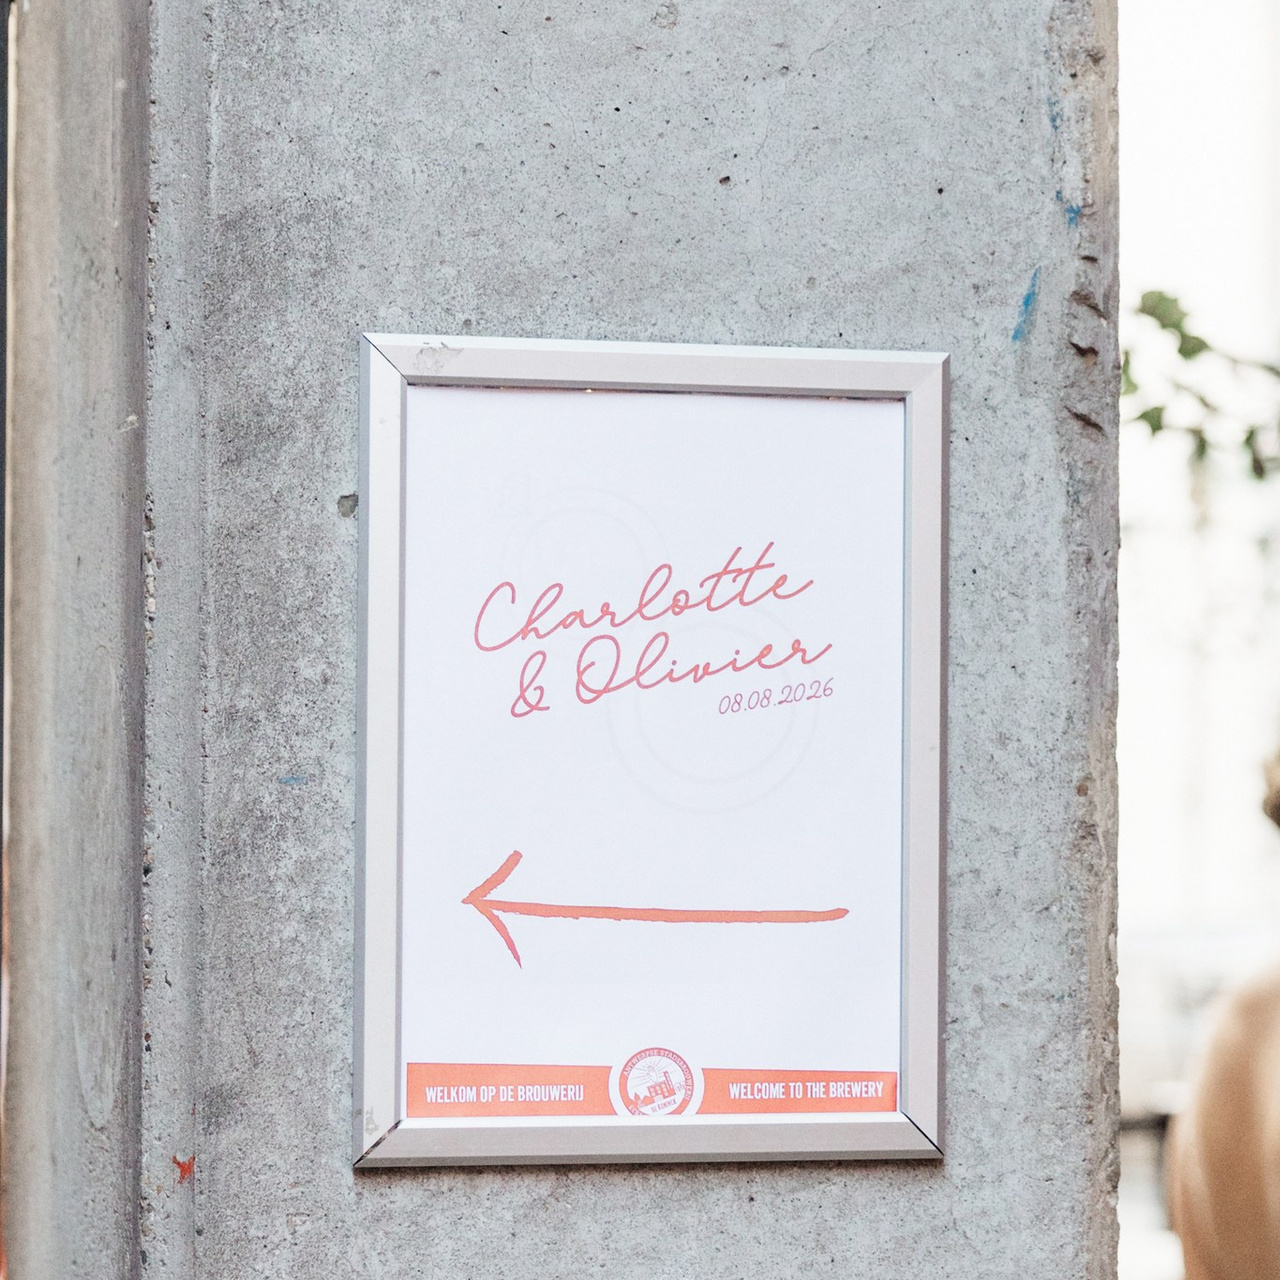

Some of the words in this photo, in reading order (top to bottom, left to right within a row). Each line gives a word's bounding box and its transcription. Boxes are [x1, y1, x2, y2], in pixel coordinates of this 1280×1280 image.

[474, 541, 814, 652] Charlotte
[510, 650, 550, 718] &
[575, 631, 832, 705] Olivier
[718, 677, 834, 715] 08.08.2026
[425, 1086, 477, 1103] WELKOM
[480, 1086, 497, 1102] OP
[499, 1086, 514, 1102] DE
[517, 1085, 584, 1102] BROUWERIJ
[729, 1082, 786, 1099] WELCOME
[789, 1082, 803, 1099] TO
[805, 1082, 827, 1099] THE
[829, 1081, 884, 1098] BREWERY
